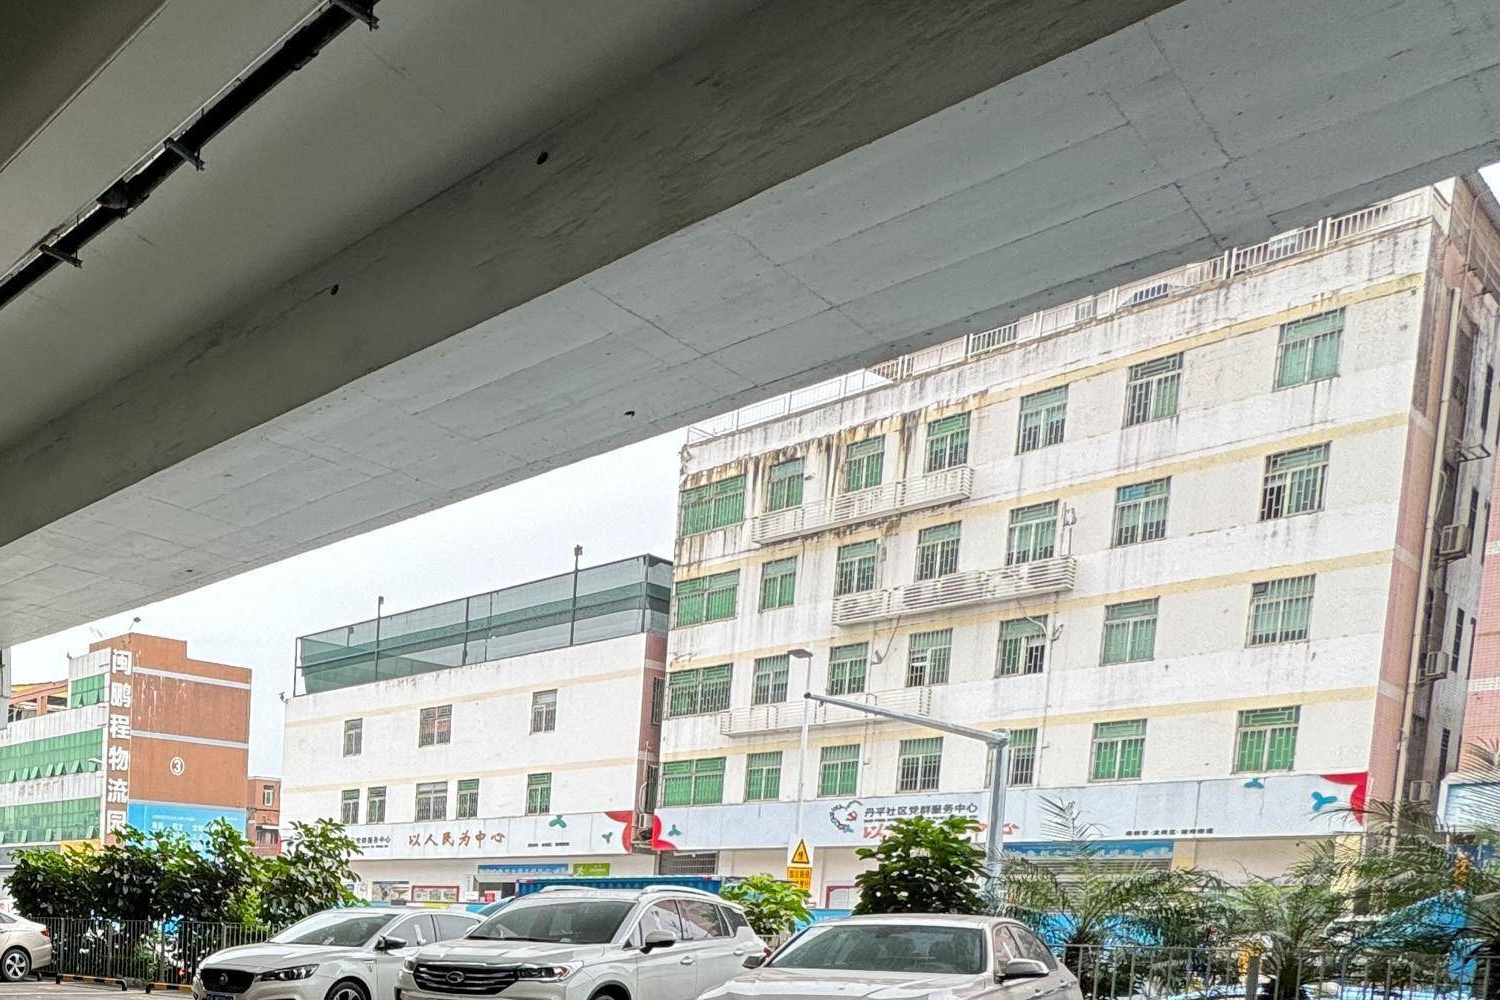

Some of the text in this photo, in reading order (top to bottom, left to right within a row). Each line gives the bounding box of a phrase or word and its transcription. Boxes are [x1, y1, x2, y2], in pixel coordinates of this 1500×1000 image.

[107, 648, 132, 834] 闽鹏程物流园
[864, 803, 978, 818] 丹平社区党群服务中心
[408, 830, 506, 848] 以人民为中心
